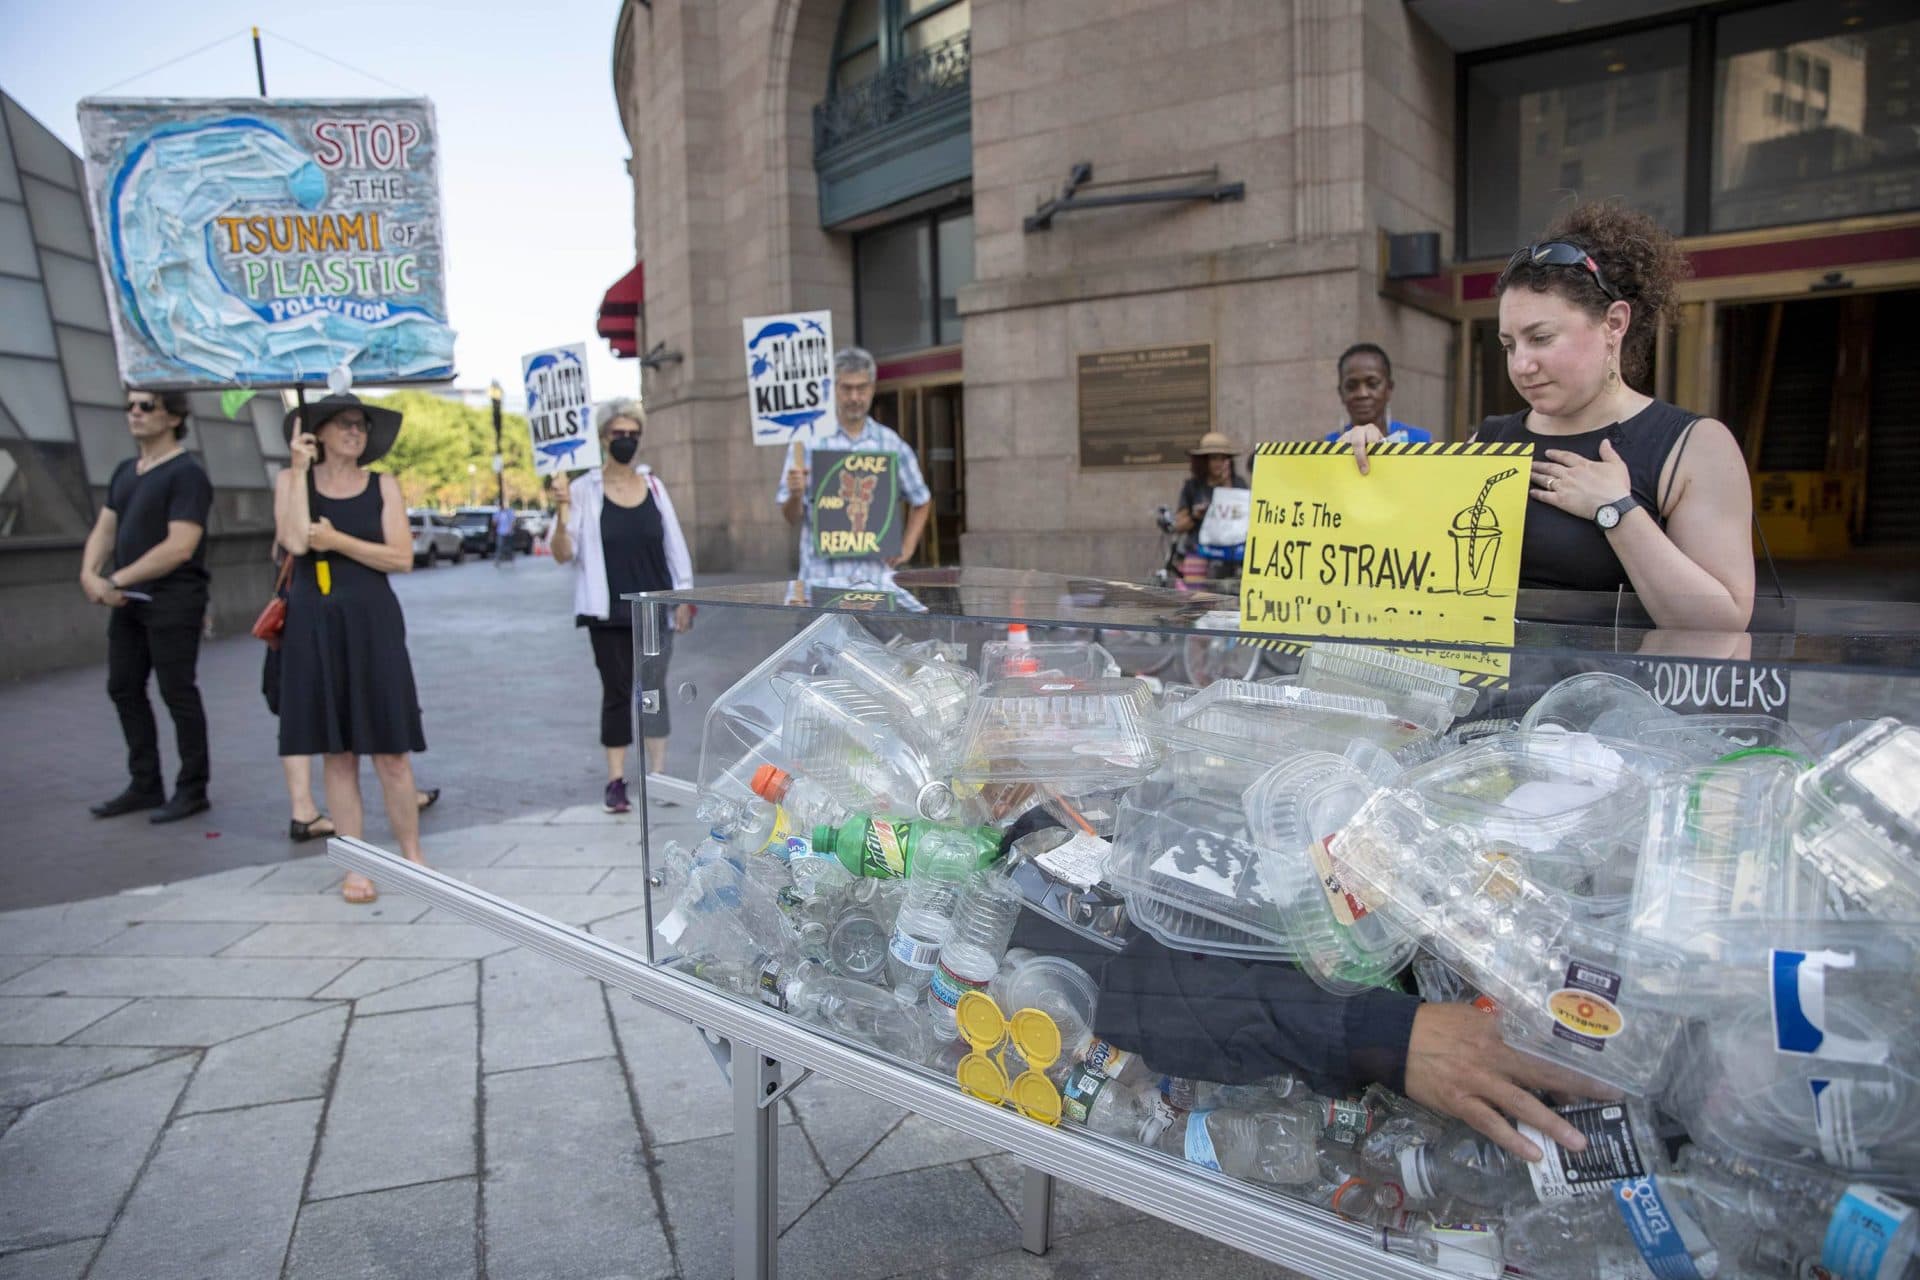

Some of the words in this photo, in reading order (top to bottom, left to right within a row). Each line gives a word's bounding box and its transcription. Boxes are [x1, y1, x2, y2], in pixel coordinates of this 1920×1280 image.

[315, 122, 417, 167] STOP
[350, 177, 401, 200] THE
[217, 212, 382, 255] TSUNAMI
[392, 224, 417, 242] OF
[246, 257, 417, 295] PLASTIC
[269, 296, 390, 321] POLLUTION
[773, 337, 828, 381] PLASTIC
[538, 367, 585, 411] PLASTIC
[756, 381, 820, 413] KILLS
[532, 410, 578, 443] KILLS
[844, 455, 888, 473] CARE
[818, 495, 844, 510] AND
[1256, 500, 1286, 525] This
[1291, 501, 1305, 528] Is
[1312, 503, 1342, 528] The
[820, 531, 880, 553] REPAIR
[1248, 536, 1312, 580] LAST
[1319, 543, 1436, 591] STRAW.
[1647, 661, 1787, 712] ODUCERS
